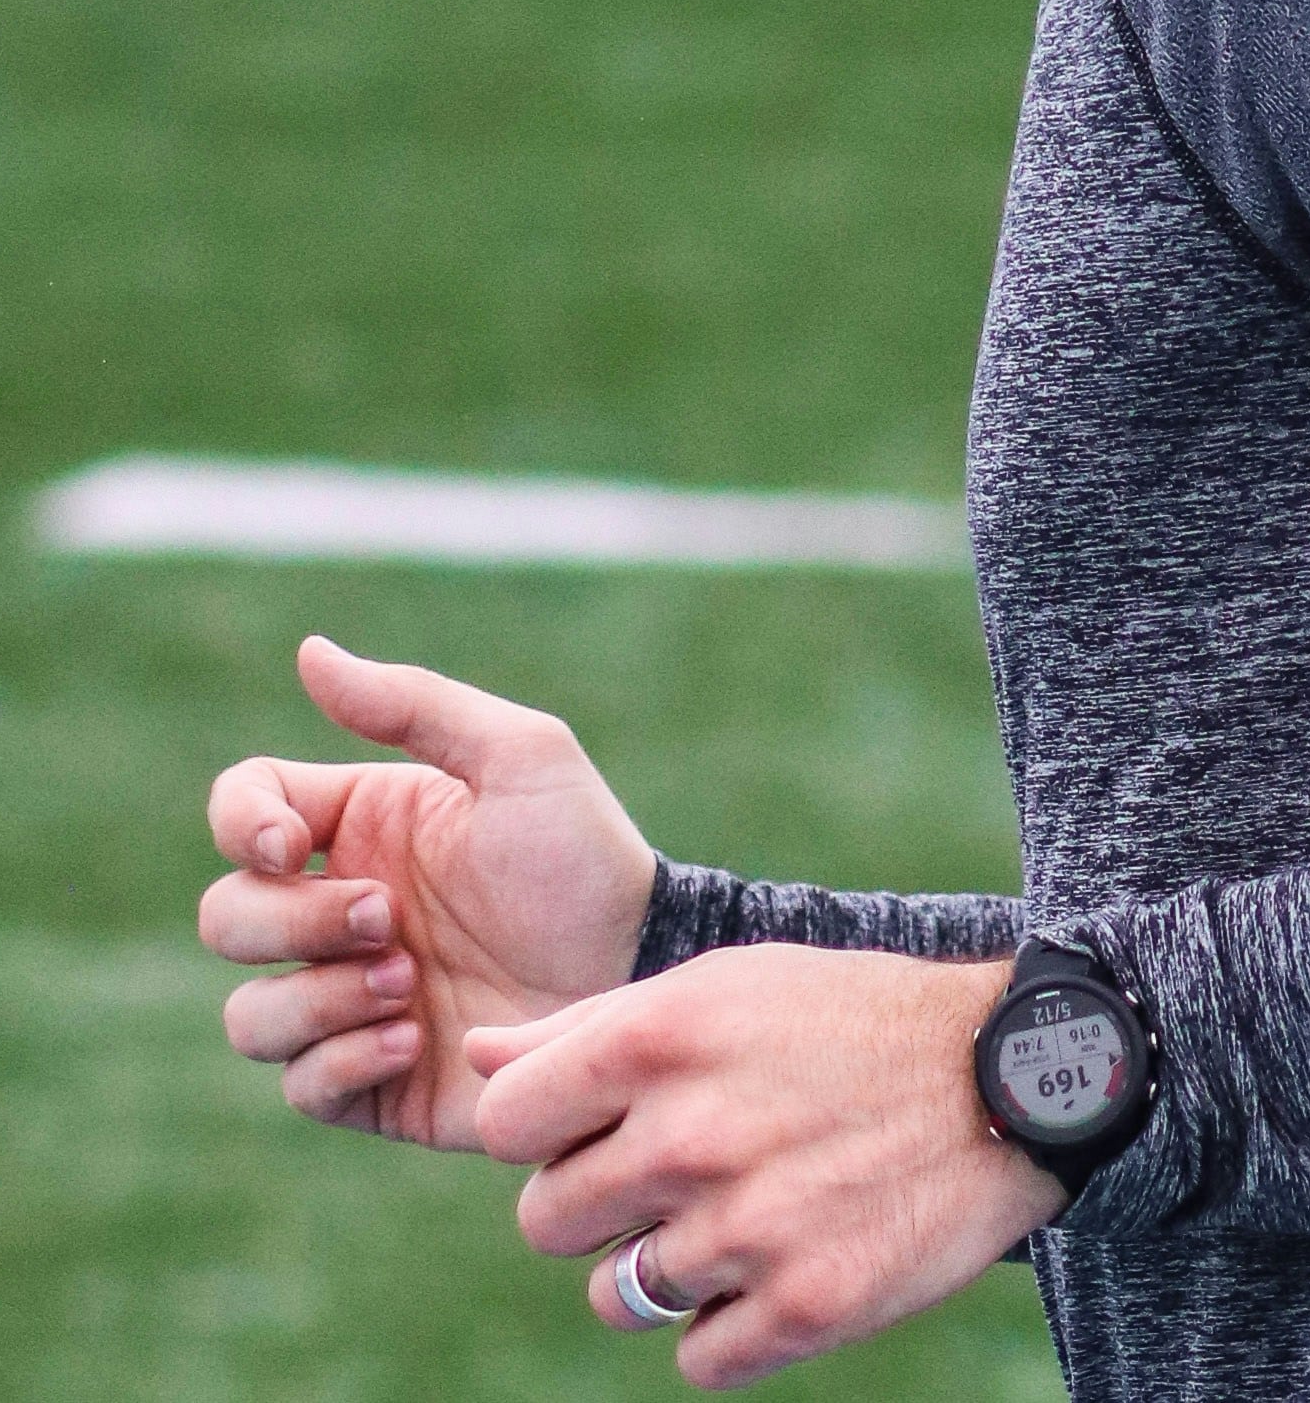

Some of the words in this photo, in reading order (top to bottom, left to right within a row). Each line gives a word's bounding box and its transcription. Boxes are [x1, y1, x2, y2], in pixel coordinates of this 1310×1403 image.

[1032, 1001, 1071, 1026] 5/12
[1069, 1024, 1100, 1043] 0:16
[1013, 1036, 1044, 1055] 7:44
[1038, 1064, 1091, 1097] 169
